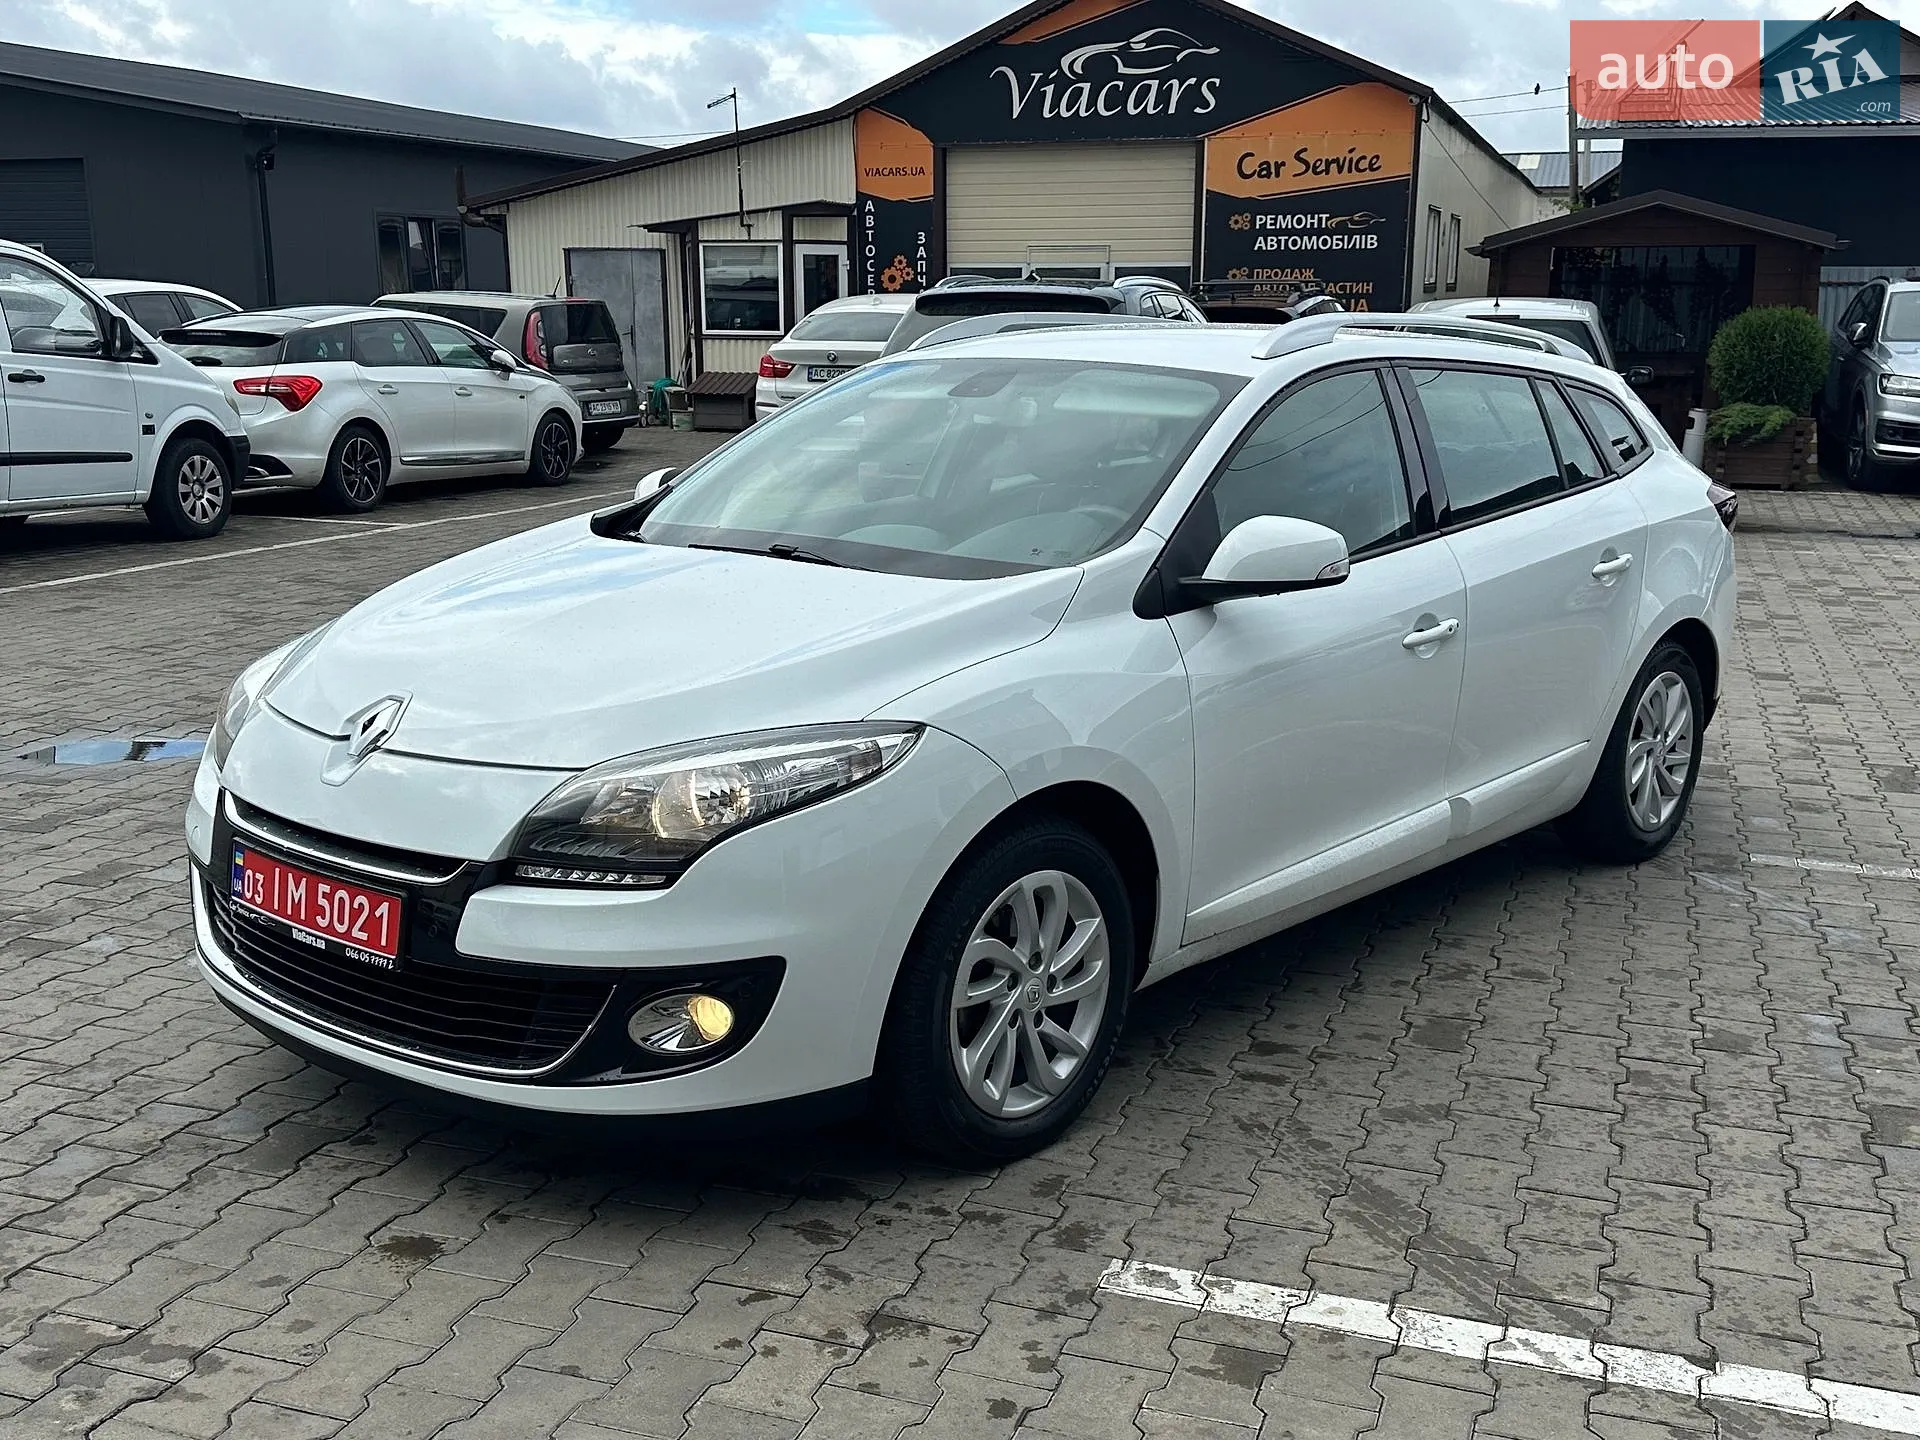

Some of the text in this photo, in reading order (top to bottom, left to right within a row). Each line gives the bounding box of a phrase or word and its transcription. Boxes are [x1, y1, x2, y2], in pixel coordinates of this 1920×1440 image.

[989, 66, 1221, 120] Viacars
[864, 166, 926, 177] VIACARS.UA
[1236, 147, 1382, 180] Car Service
[1255, 213, 1330, 230] РЕМОНТ
[1253, 234, 1379, 251] АВТОМОБІЛІВ
[1253, 268, 1315, 280] ПРОДАЖ
[813, 369, 825, 378] AC
[244, 869, 265, 905] 03
[315, 883, 390, 947] 5021
